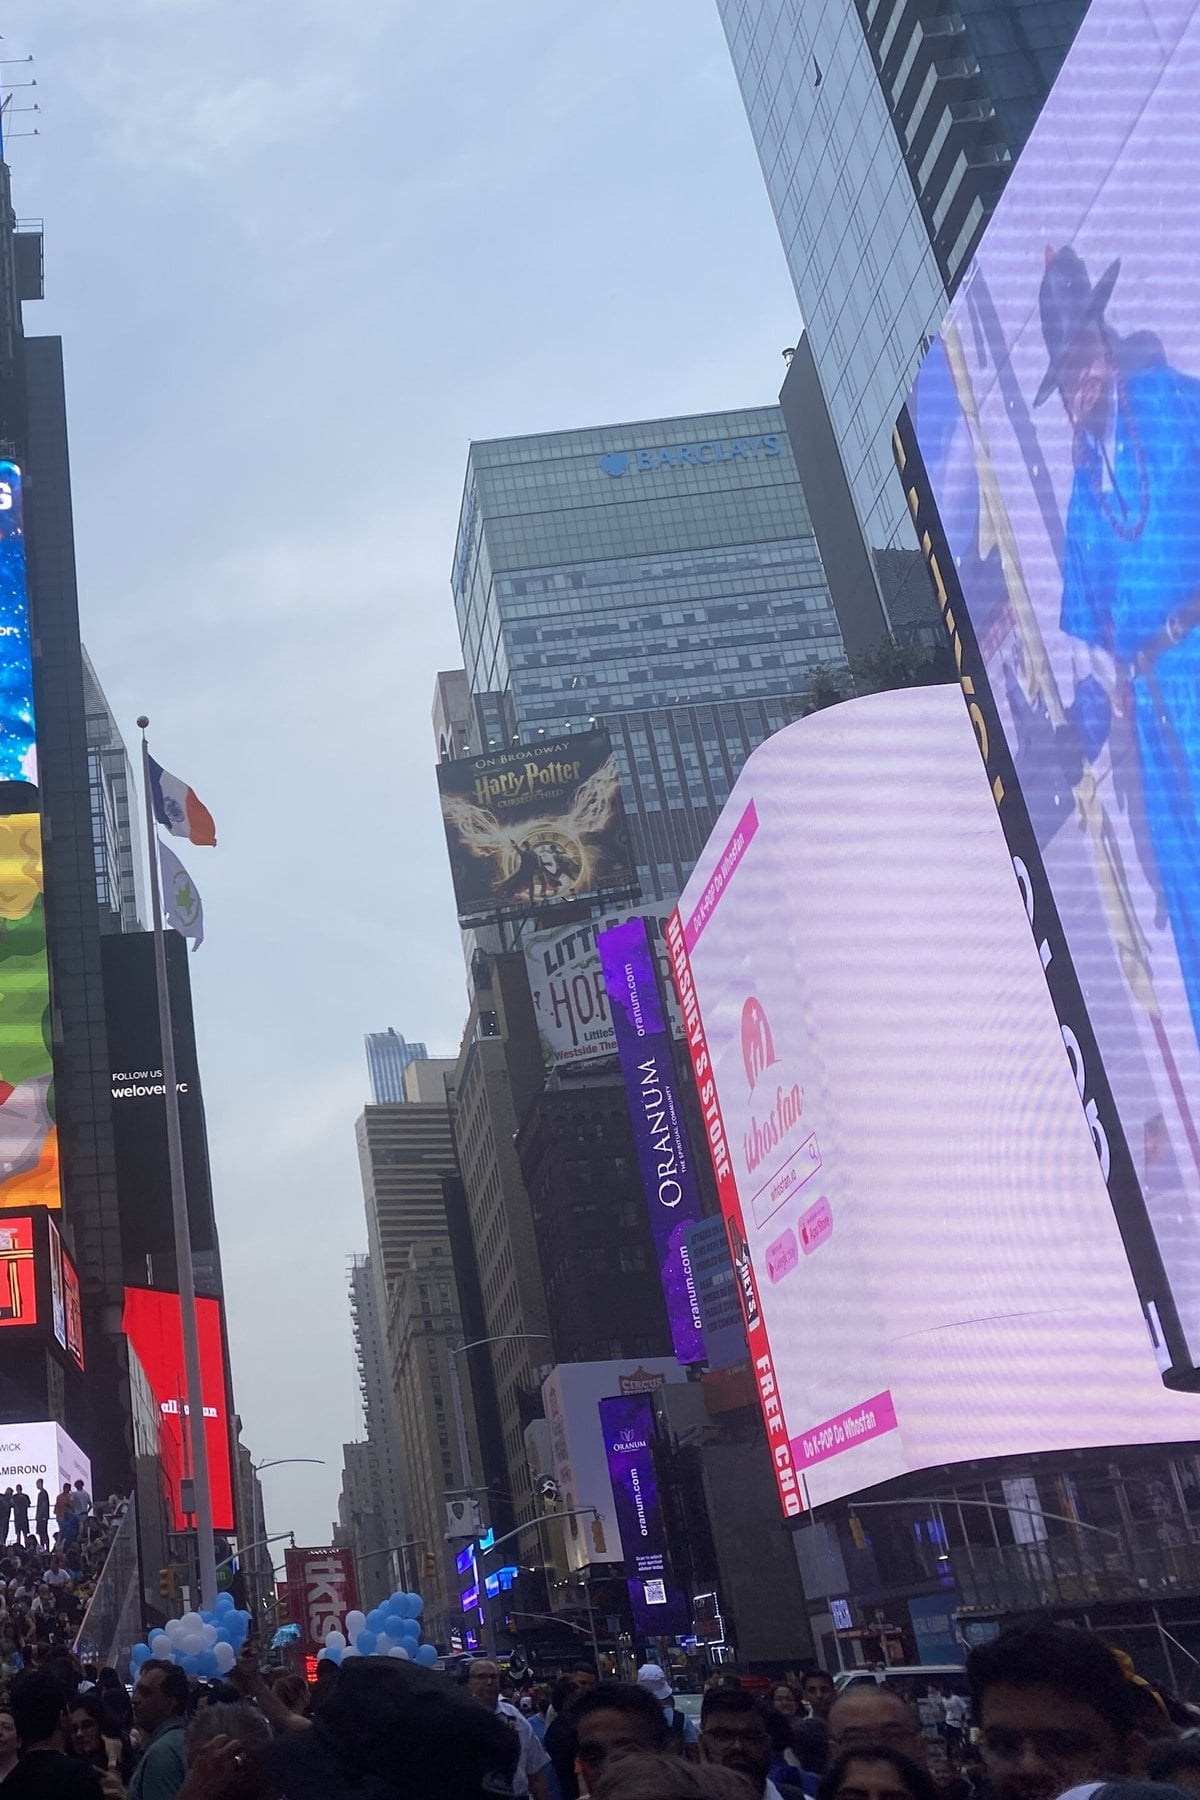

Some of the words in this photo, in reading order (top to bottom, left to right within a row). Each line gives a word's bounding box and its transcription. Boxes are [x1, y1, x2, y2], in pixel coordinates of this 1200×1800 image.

[637, 434, 782, 472] BARCLAYS
[500, 742, 570, 764] BROADWAY
[474, 771, 525, 805] Harry
[524, 760, 581, 799] Potter
[625, 963, 646, 1037] oranum.com
[668, 914, 709, 1077] HERSHEY'S
[554, 1043, 598, 1061] Westside
[600, 1040, 618, 1051] The
[584, 1027, 615, 1042] LittleS
[676, 1025, 687, 1034] 43
[111, 1070, 149, 1082] FOLLOW
[150, 1069, 163, 1079] US
[665, 1086, 678, 1126] COMMUNITY
[637, 1057, 682, 1208] ORANUM
[674, 1125, 685, 1159] SPIRITUAL
[701, 1085, 732, 1185] STORE
[679, 1245, 702, 1329] oranum.com
[621, 1377, 663, 1390] CIRCUS
[756, 1353, 783, 1435] FREE
[613, 1440, 647, 1452] ORANUM
[812, 1427, 834, 1455] K-POP
[843, 1409, 877, 1440] Whosfan
[630, 1467, 649, 1537] oranum.com
[775, 1444, 801, 1517] CHO
[304, 1557, 347, 1645] tkts
